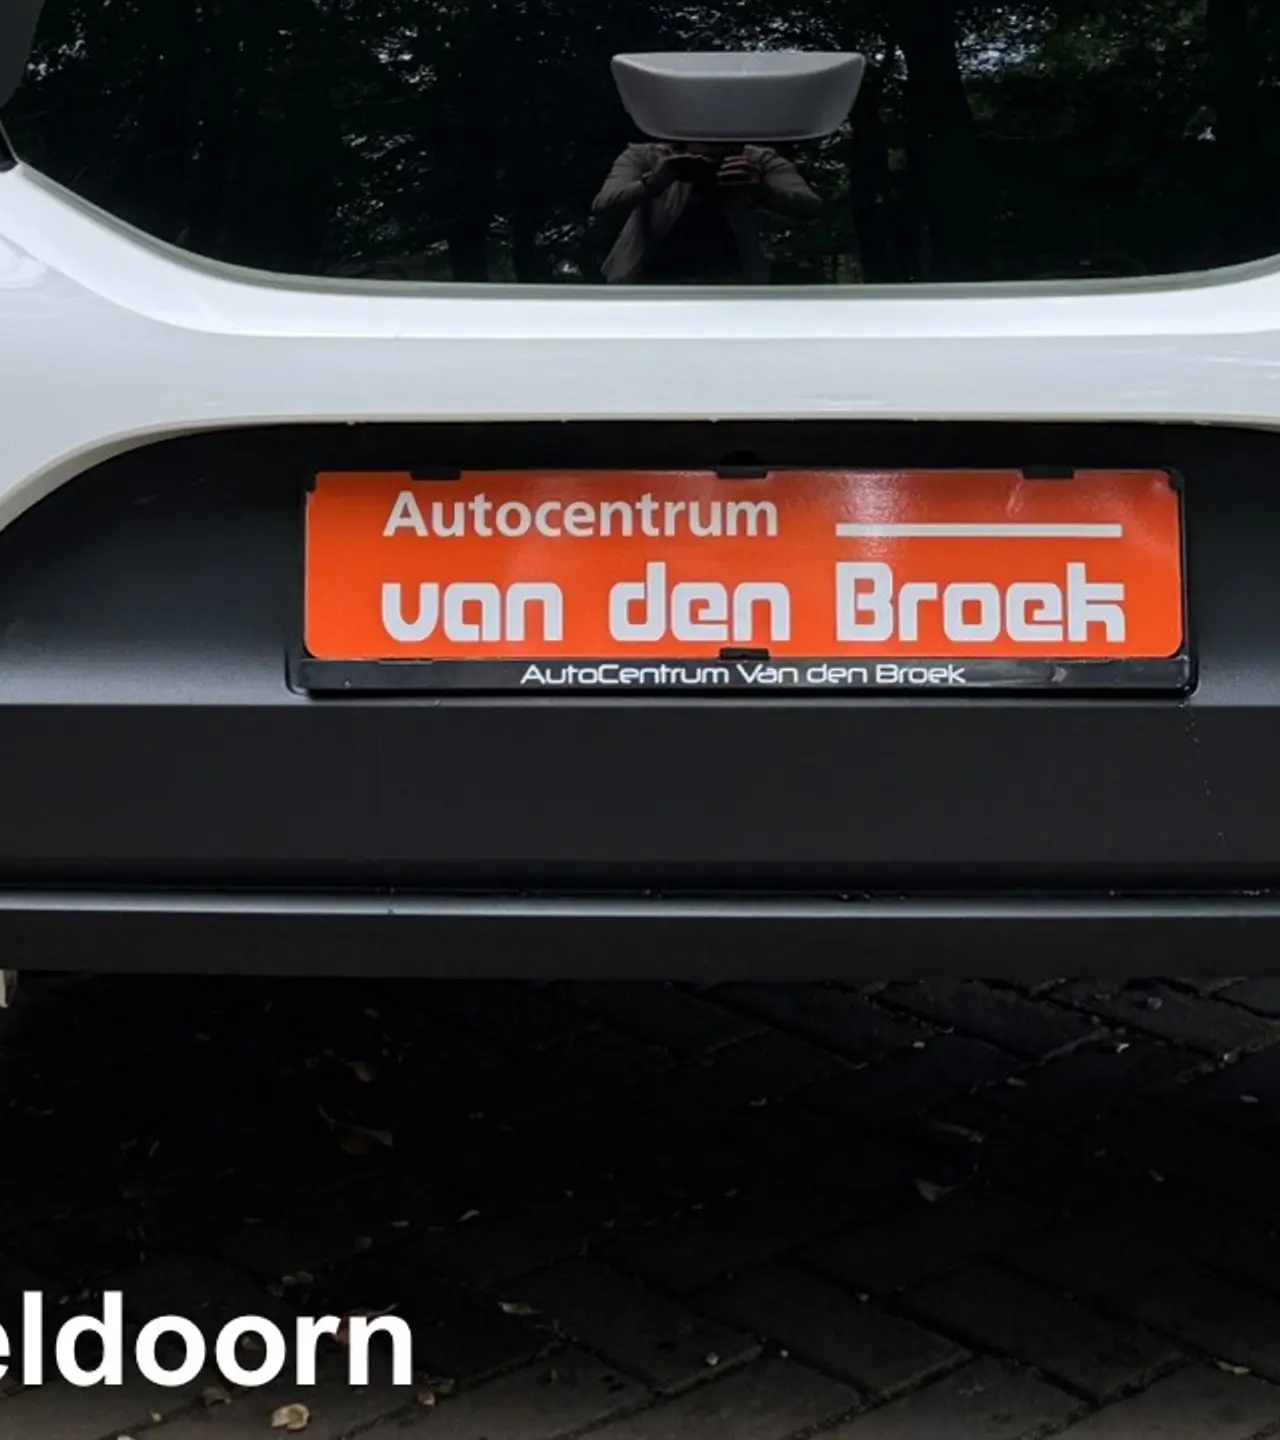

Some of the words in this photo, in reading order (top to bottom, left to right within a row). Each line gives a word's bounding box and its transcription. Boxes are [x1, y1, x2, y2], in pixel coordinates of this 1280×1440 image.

[383, 491, 779, 537] Autocentrum
[382, 582, 563, 642] van
[609, 562, 790, 642] den
[836, 561, 1125, 642] Broek
[520, 662, 729, 686] AutoCentrum
[737, 662, 796, 686] Van
[806, 662, 867, 686] den
[875, 662, 966, 686] Broek
